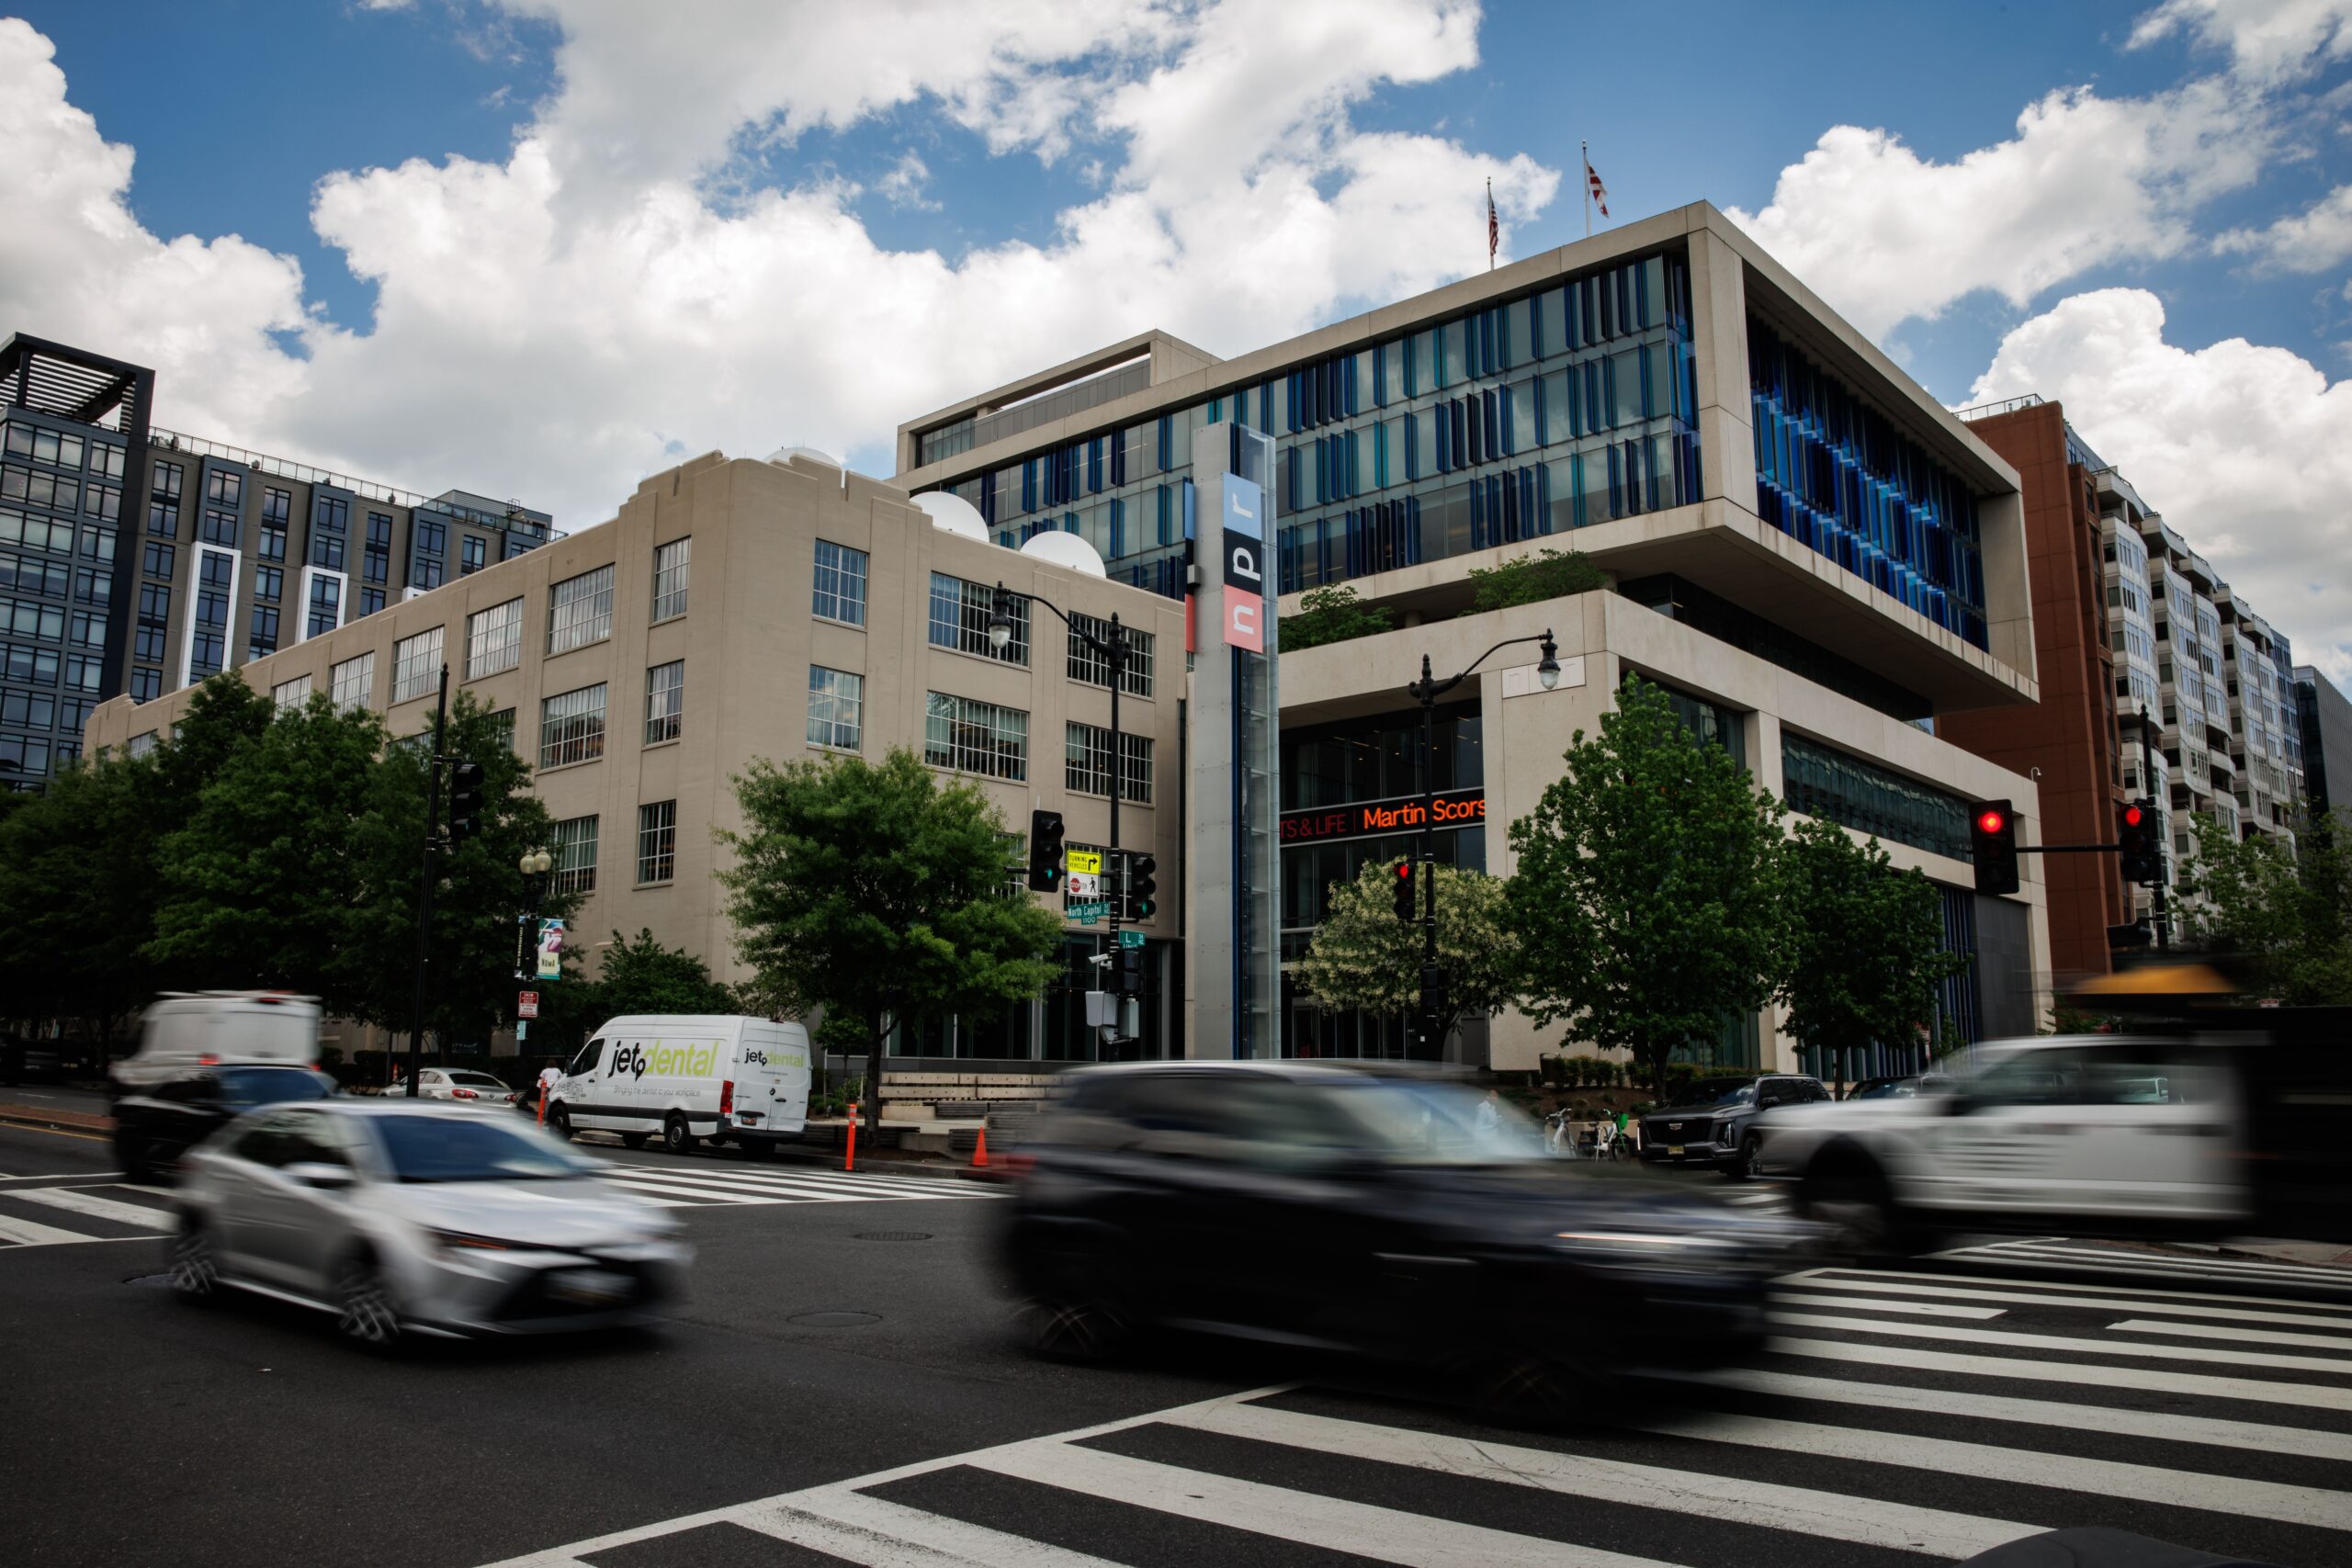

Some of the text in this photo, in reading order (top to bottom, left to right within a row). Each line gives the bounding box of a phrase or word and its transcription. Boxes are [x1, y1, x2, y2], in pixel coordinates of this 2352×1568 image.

[1232, 491, 1261, 635] npr
[1300, 818, 1313, 837] &
[1316, 813, 1347, 835] LIFE
[1363, 802, 1426, 829] Martin
[1068, 907, 1082, 918] North
[1083, 905, 1102, 917] Capitol
[1125, 932, 1132, 943] L
[643, 1038, 719, 1077] dental
